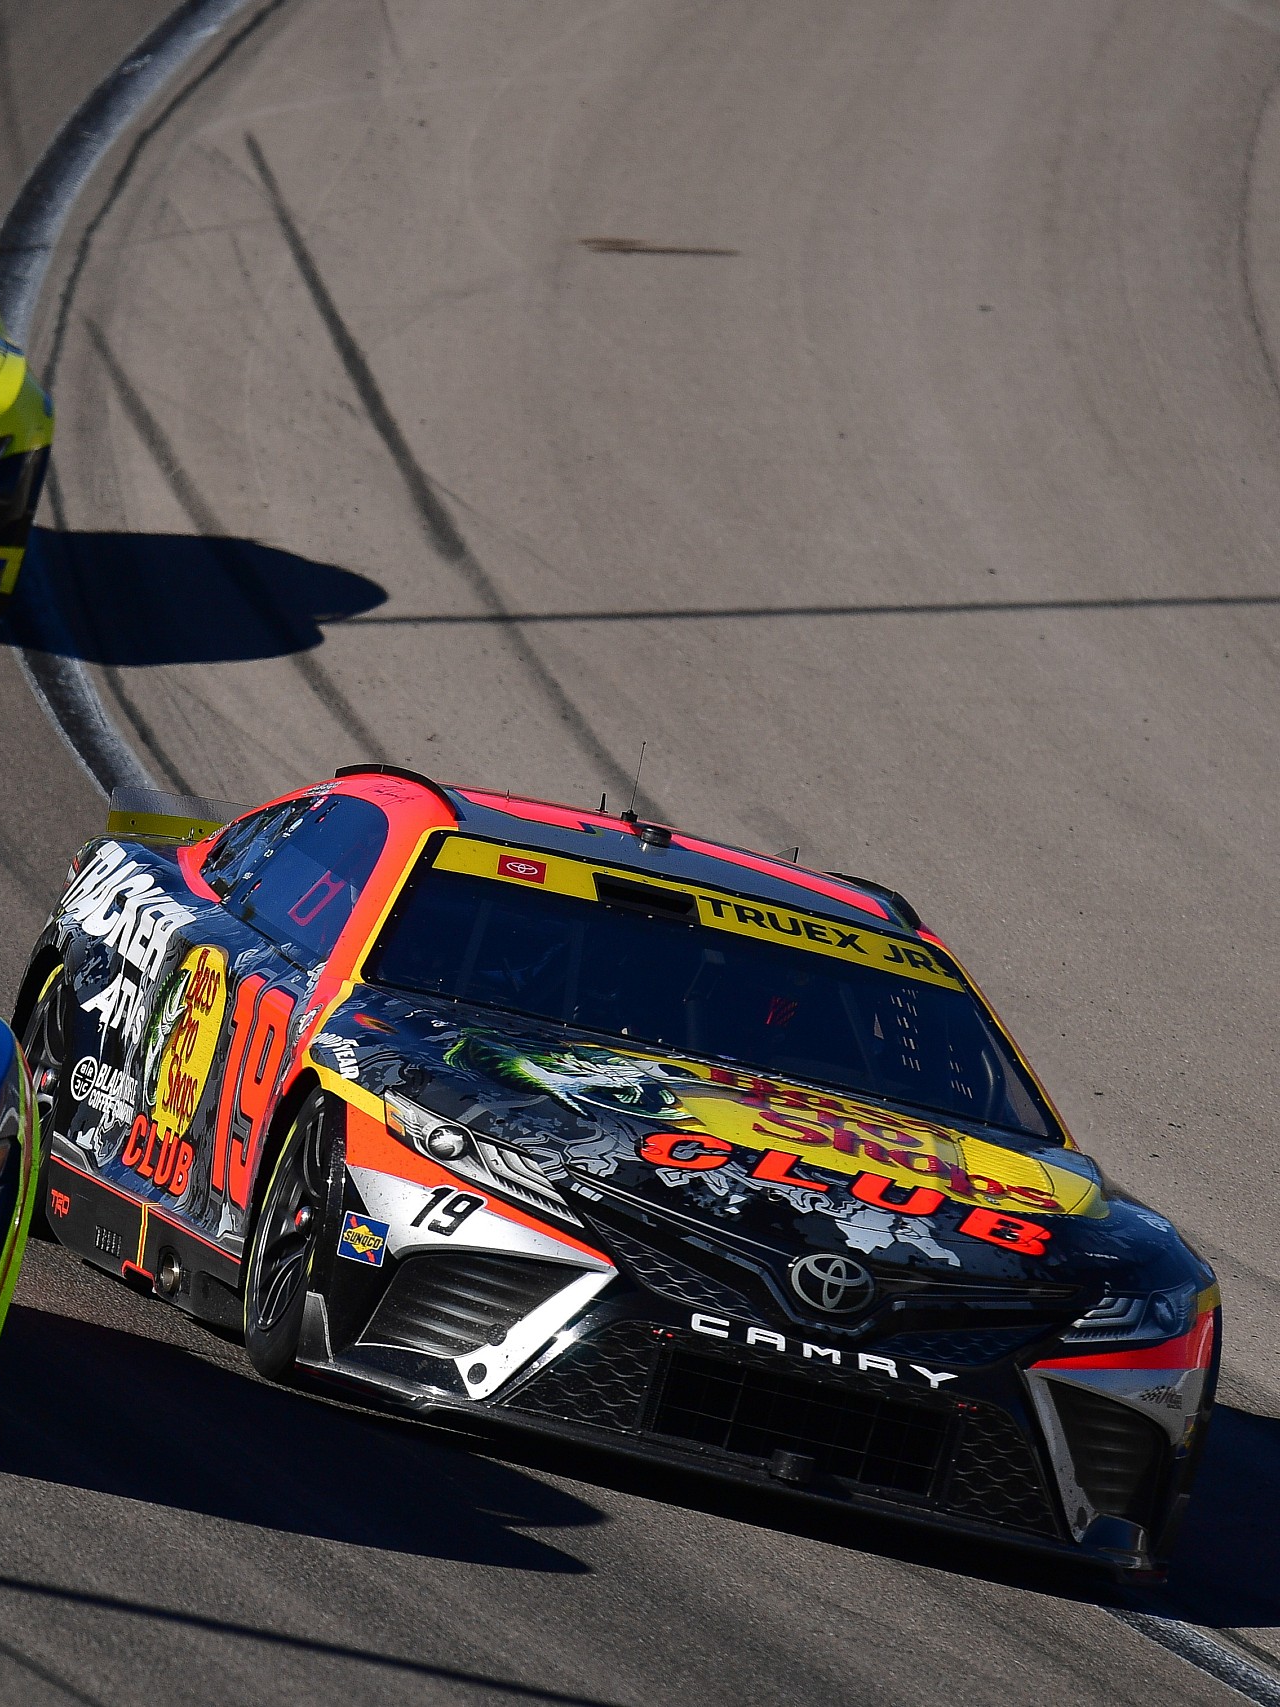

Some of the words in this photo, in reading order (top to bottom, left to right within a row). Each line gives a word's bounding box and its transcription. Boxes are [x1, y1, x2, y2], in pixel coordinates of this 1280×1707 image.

[60, 841, 197, 982] TRACKER
[698, 894, 869, 955] TRUEX
[212, 972, 296, 1211] 19
[122, 1113, 194, 1197] CLUB
[637, 1132, 1054, 1257] CLUB
[343, 1229, 382, 1249] SUNOCO
[409, 1186, 486, 1237] 19
[690, 1312, 959, 1389] CAMRY
